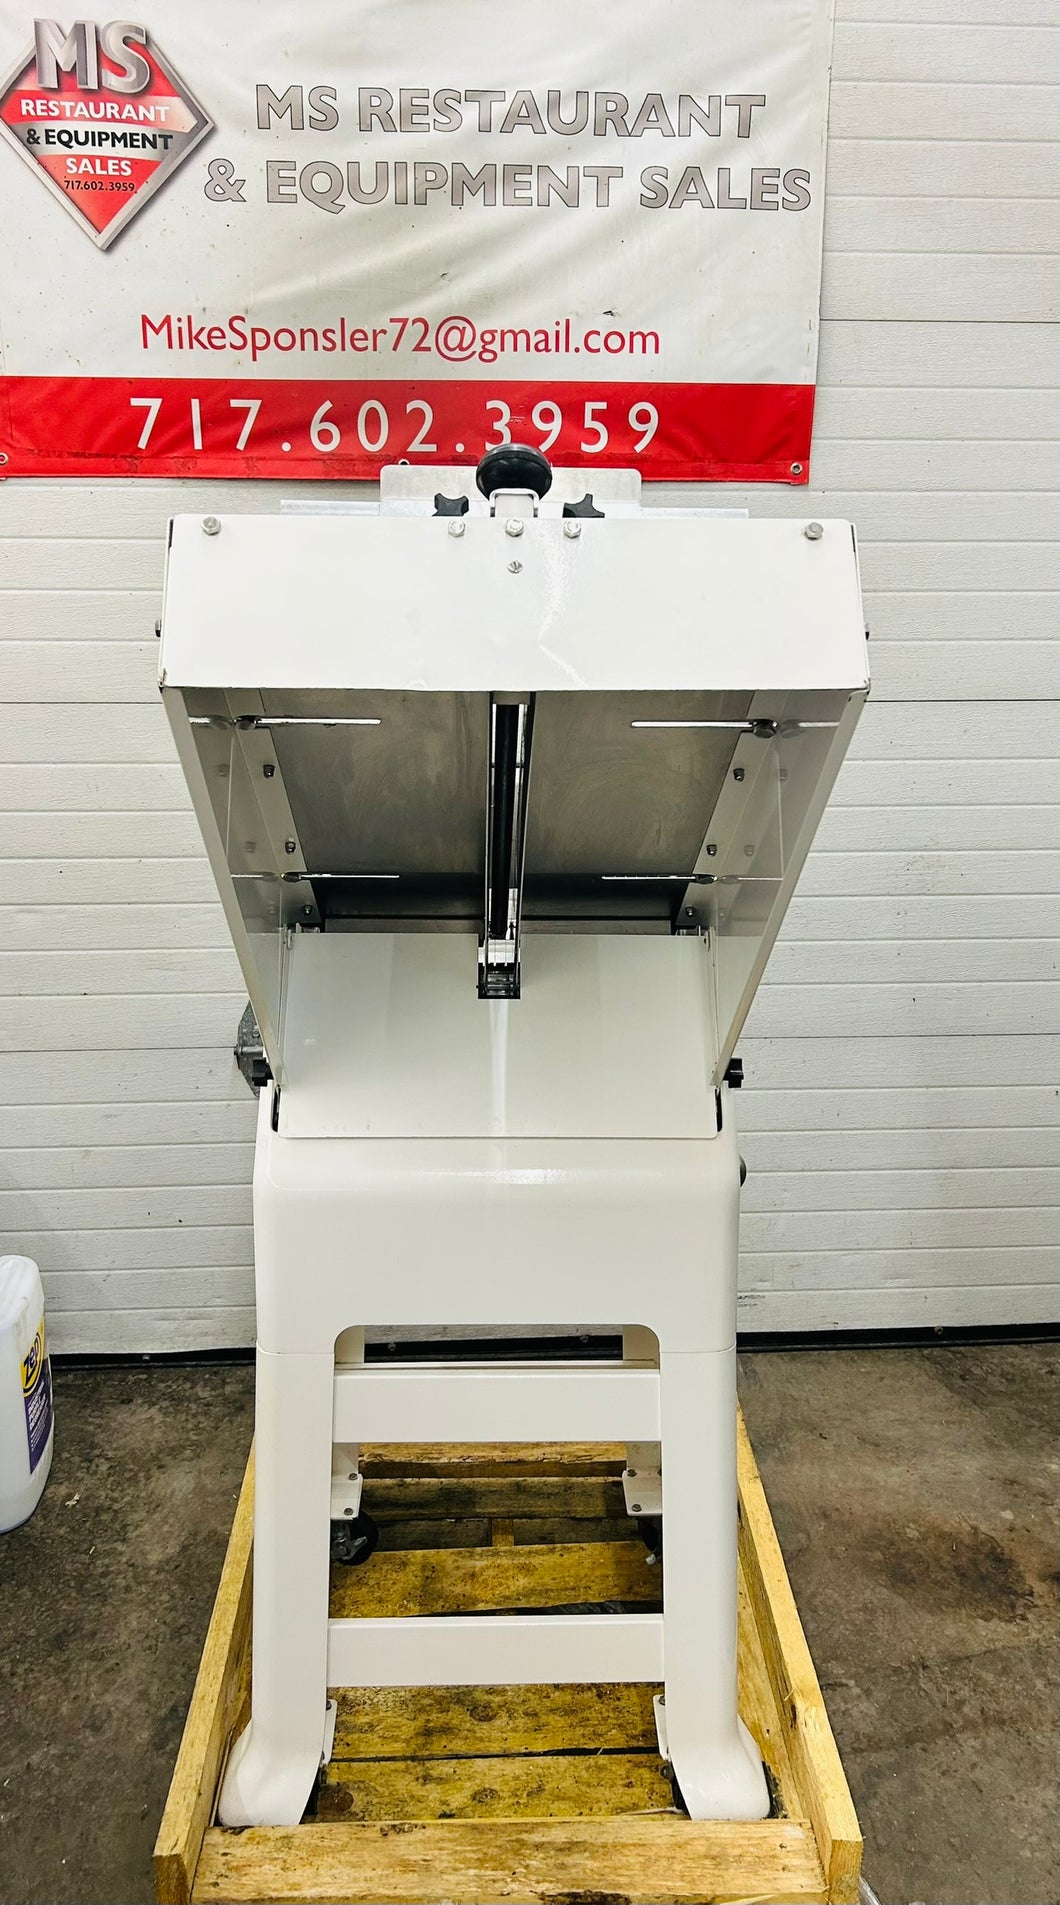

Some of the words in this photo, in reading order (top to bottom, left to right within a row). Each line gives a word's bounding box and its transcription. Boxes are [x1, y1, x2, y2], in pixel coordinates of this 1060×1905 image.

[33, 17, 150, 95] MS
[20, 98, 170, 122] RESTAURANT
[256, 83, 340, 132] MS
[358, 86, 767, 139] RESTAURANT
[26, 128, 41, 146] &
[45, 128, 174, 150] EQUIPMENT
[65, 157, 133, 177] SALES
[203, 157, 248, 204] &
[267, 160, 623, 214] EQUIPMENT
[639, 165, 813, 213] SALES
[63, 180, 136, 193] 717.602.3959
[141, 313, 661, 364] MikeSponsler72@gmail.com
